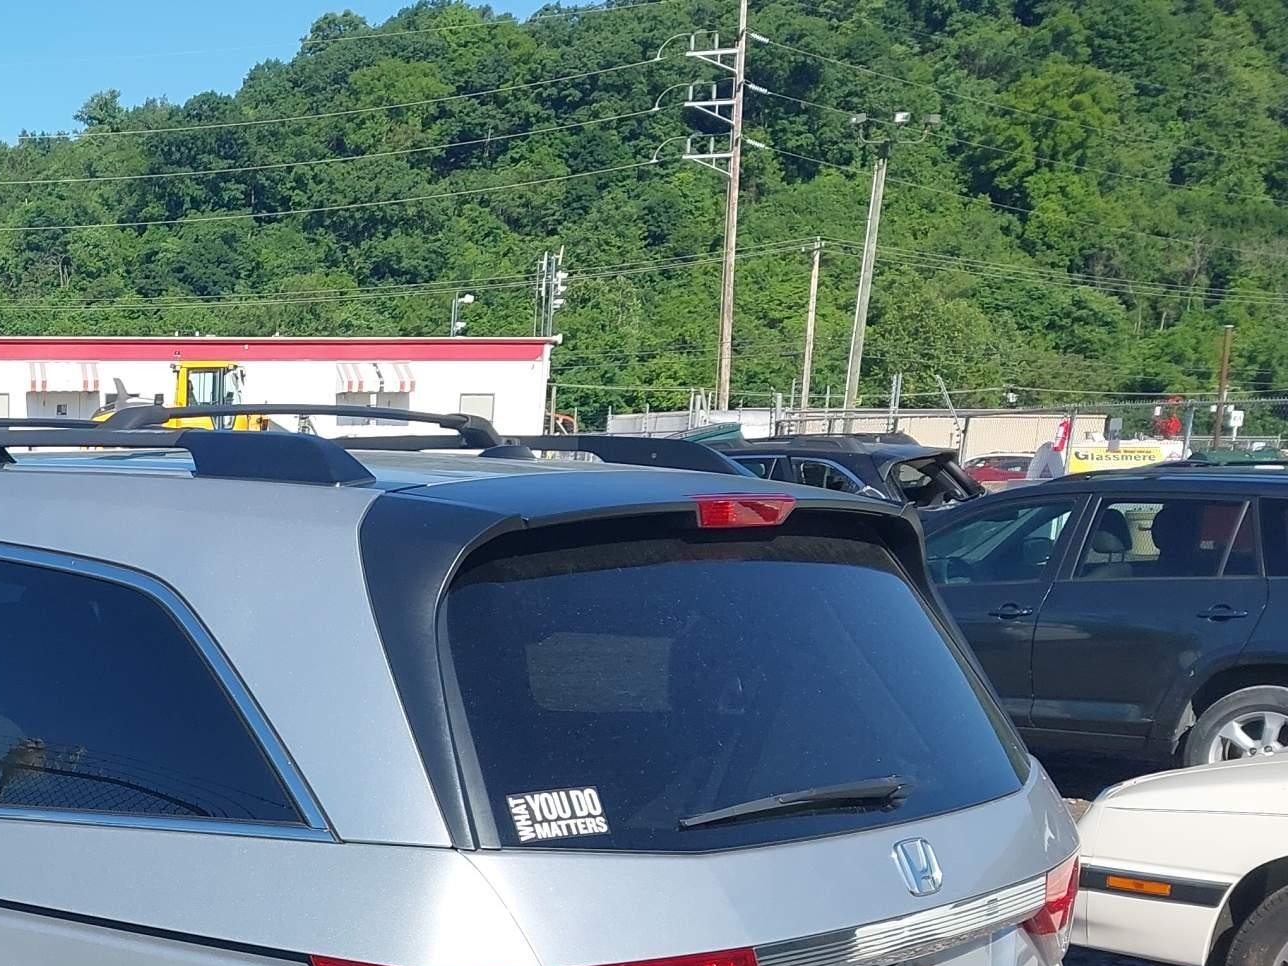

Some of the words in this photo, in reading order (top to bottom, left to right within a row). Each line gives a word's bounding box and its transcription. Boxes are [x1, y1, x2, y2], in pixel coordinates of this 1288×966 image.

[1074, 451, 1156, 461] Glassmere
[524, 790, 572, 821] YOU
[569, 788, 602, 817] DO
[508, 797, 536, 841] WHAT
[534, 816, 608, 839] MATTERS
